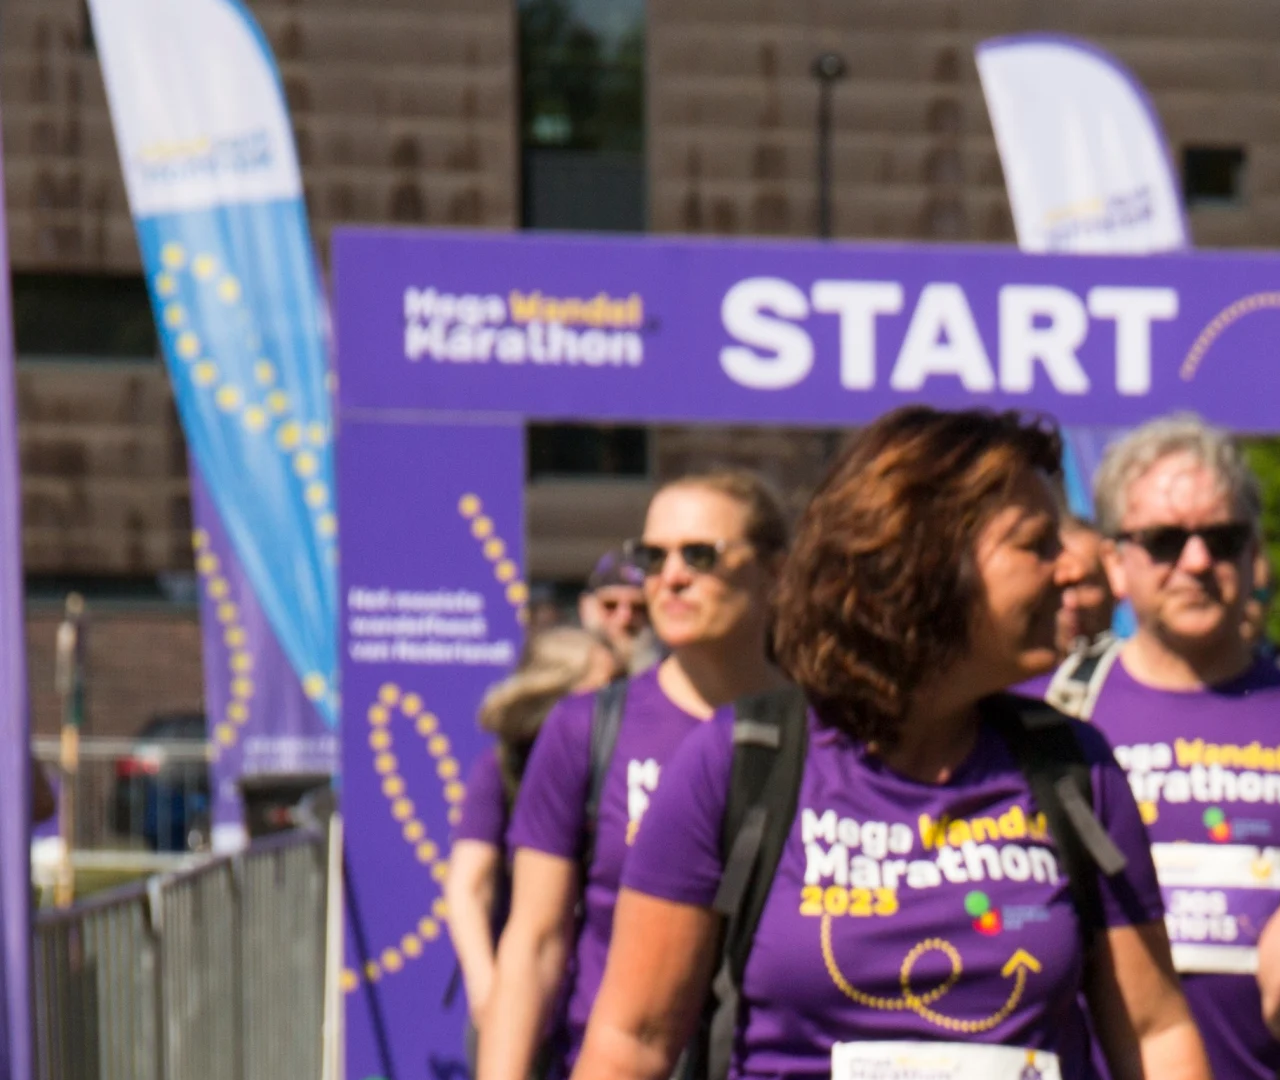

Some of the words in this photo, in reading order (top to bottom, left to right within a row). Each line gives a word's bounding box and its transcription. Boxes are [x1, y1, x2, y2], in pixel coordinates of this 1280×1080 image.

[404, 286, 506, 326] Mega
[510, 289, 643, 328] Wandel
[404, 319, 643, 366] Marathon
[719, 276, 1178, 395] START
[801, 807, 913, 859] Mega
[804, 840, 1061, 889] Marathon
[799, 885, 898, 916] 2023
